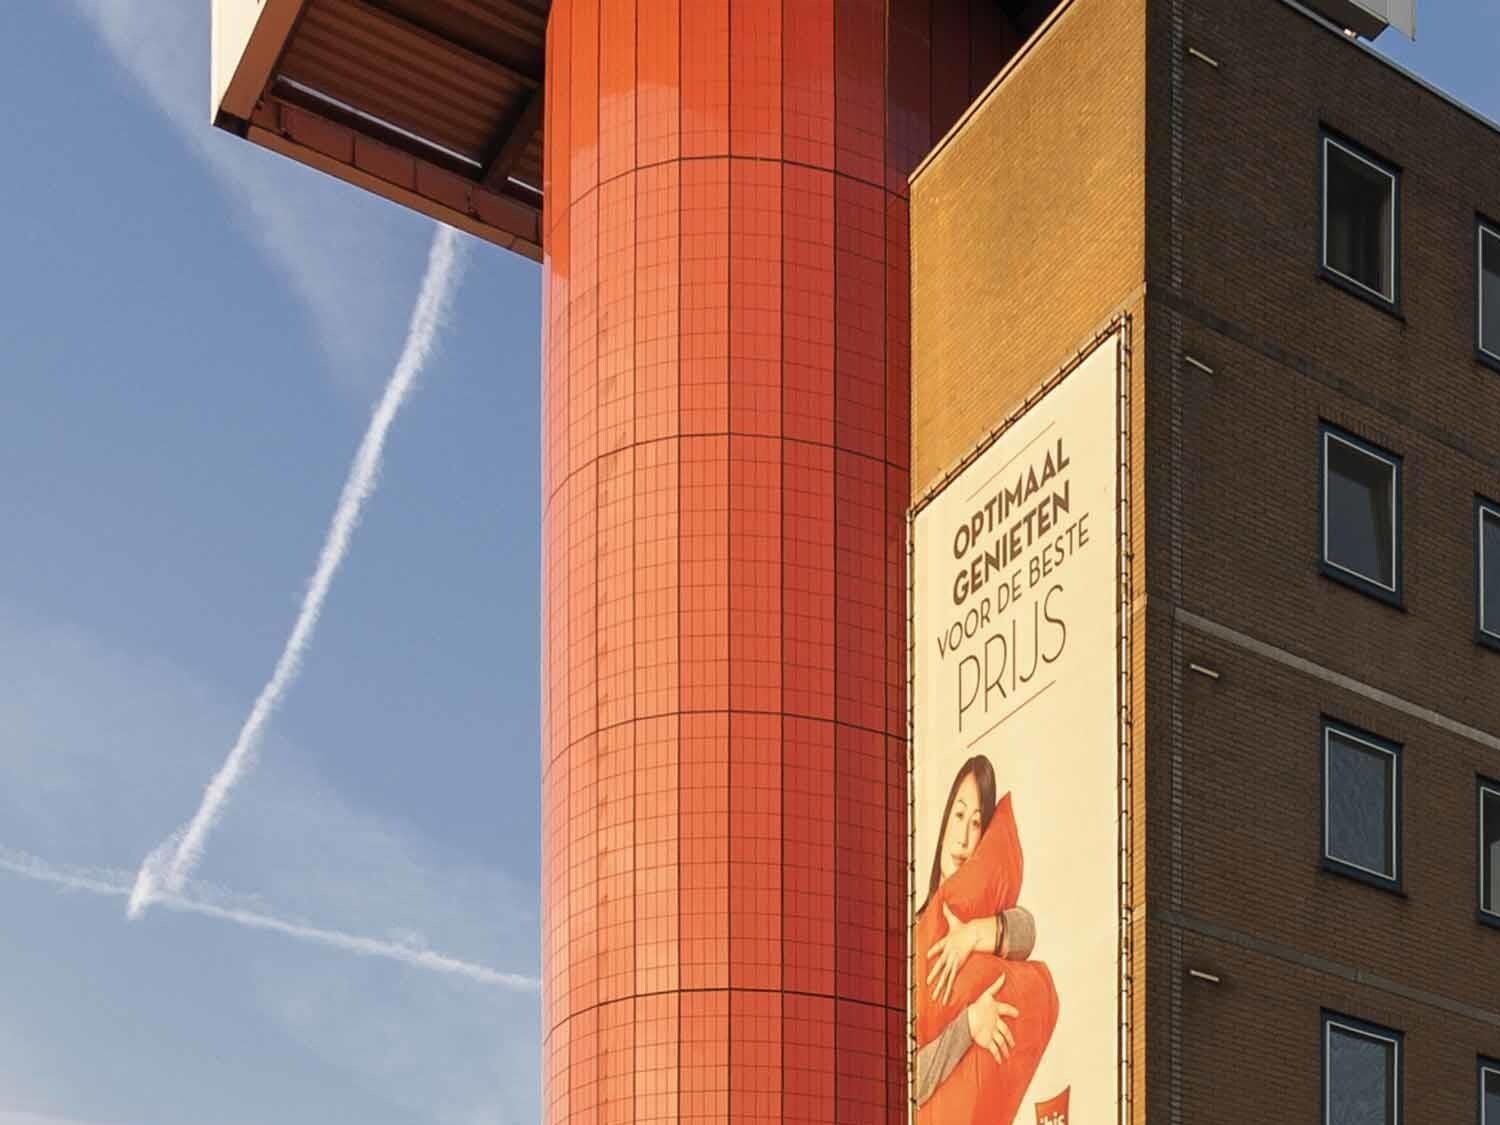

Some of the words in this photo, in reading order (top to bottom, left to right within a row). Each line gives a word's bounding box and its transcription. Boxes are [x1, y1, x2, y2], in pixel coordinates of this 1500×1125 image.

[953, 437, 1071, 560] OPTIMAAL
[953, 479, 1070, 606] GENIETEN
[937, 597, 991, 660] VOOR
[997, 569, 1022, 615] DE
[1028, 512, 1090, 589] BESTE
[958, 584, 1067, 734] PRIJS
